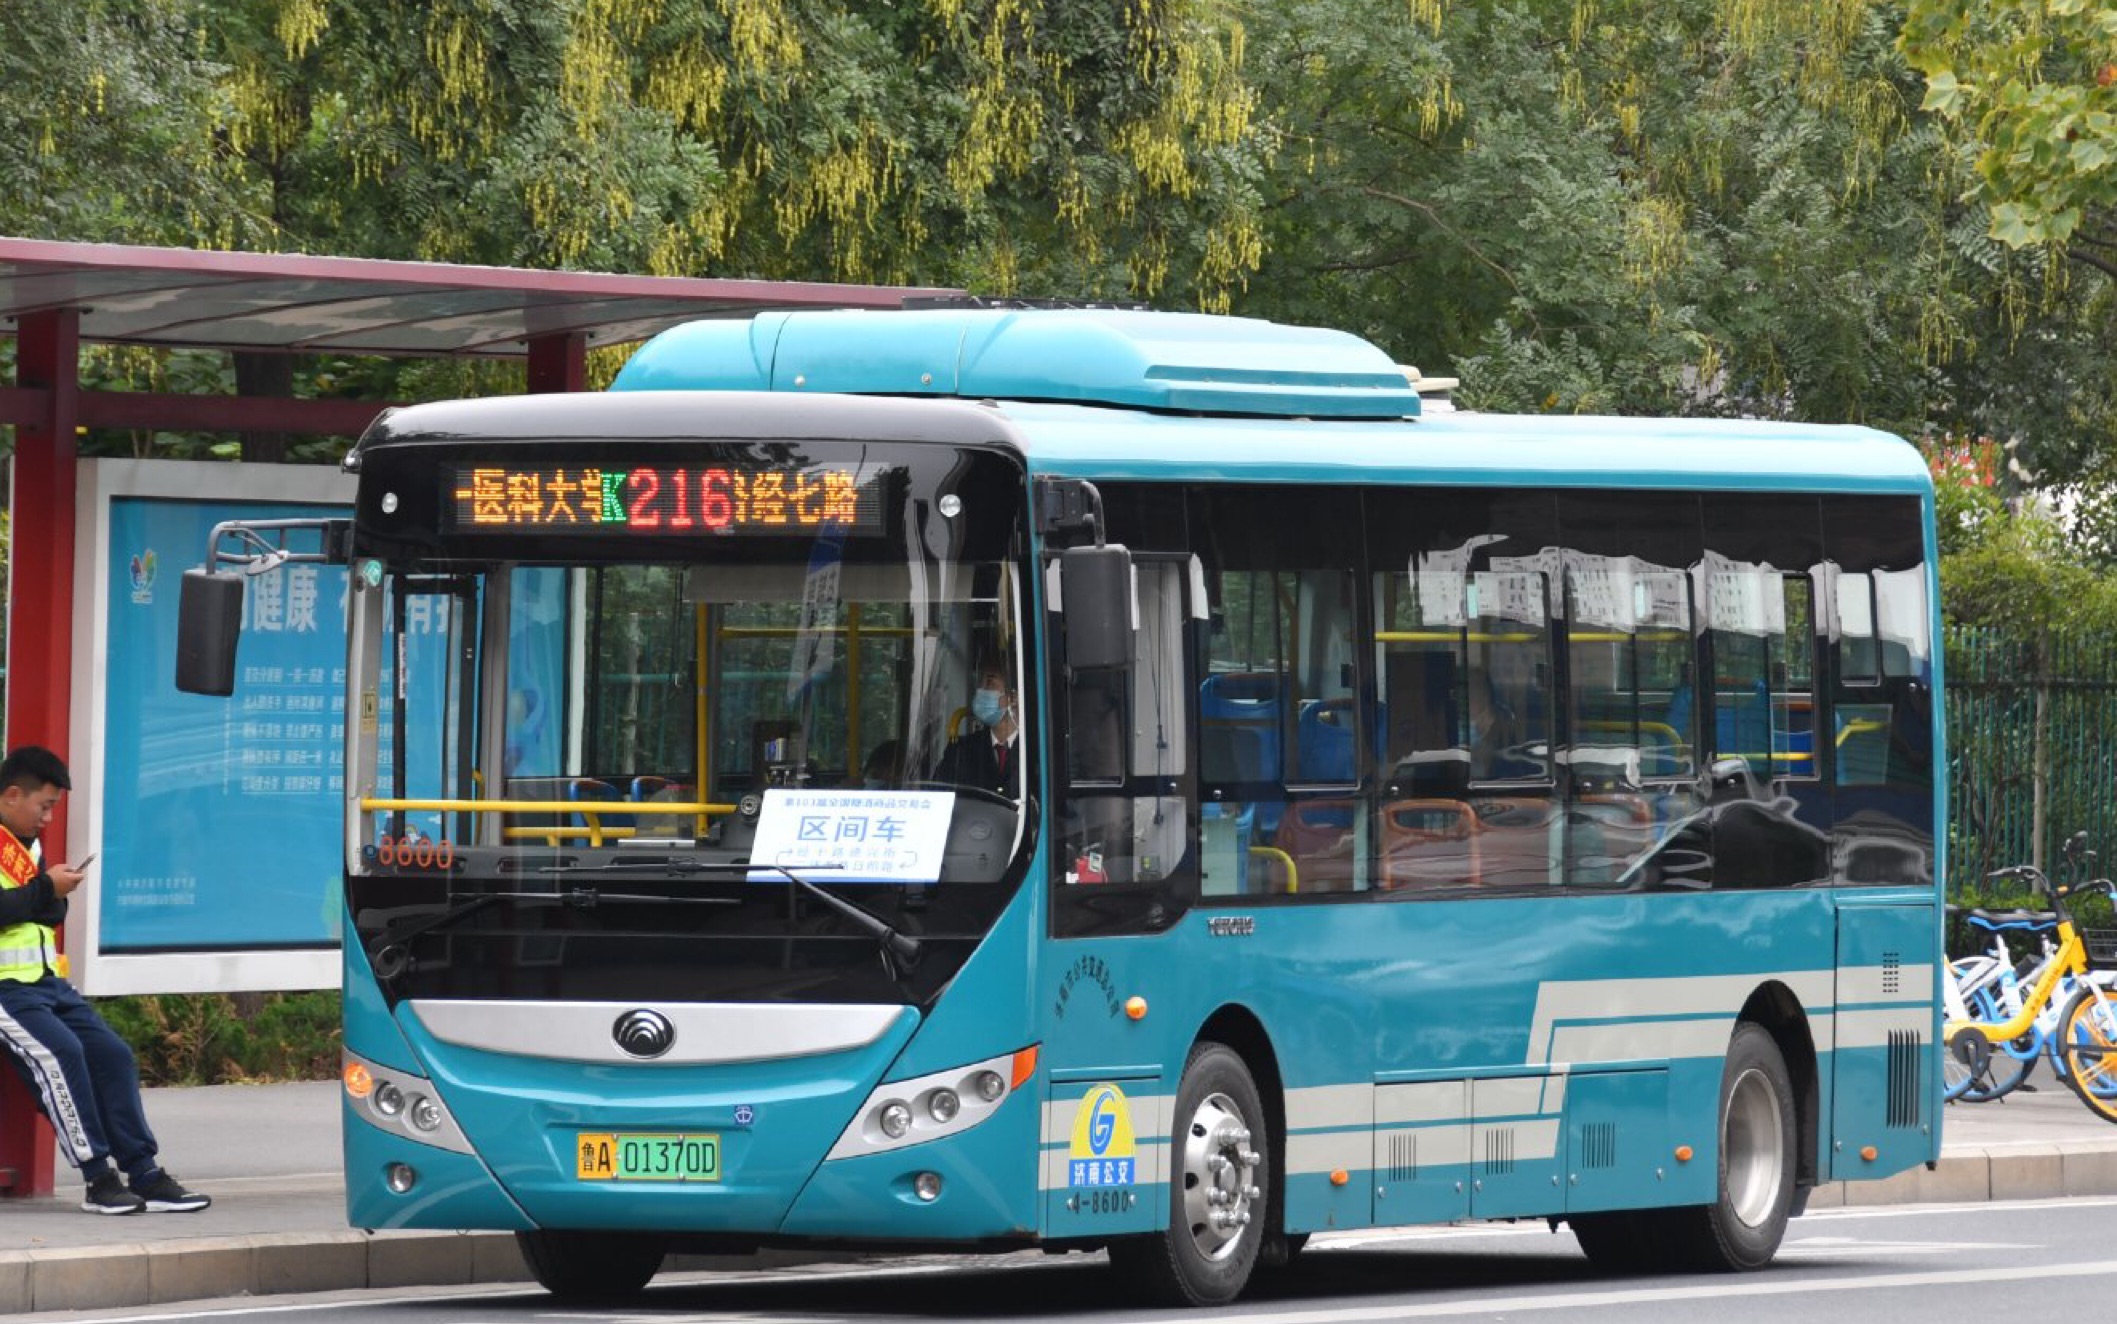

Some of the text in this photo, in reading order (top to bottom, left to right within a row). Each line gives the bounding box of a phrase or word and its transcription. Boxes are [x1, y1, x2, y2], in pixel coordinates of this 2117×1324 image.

[797, 815, 907, 843] 区间车
[379, 836, 453, 868] 8600
[1074, 1161, 1129, 1186] 济南公交
